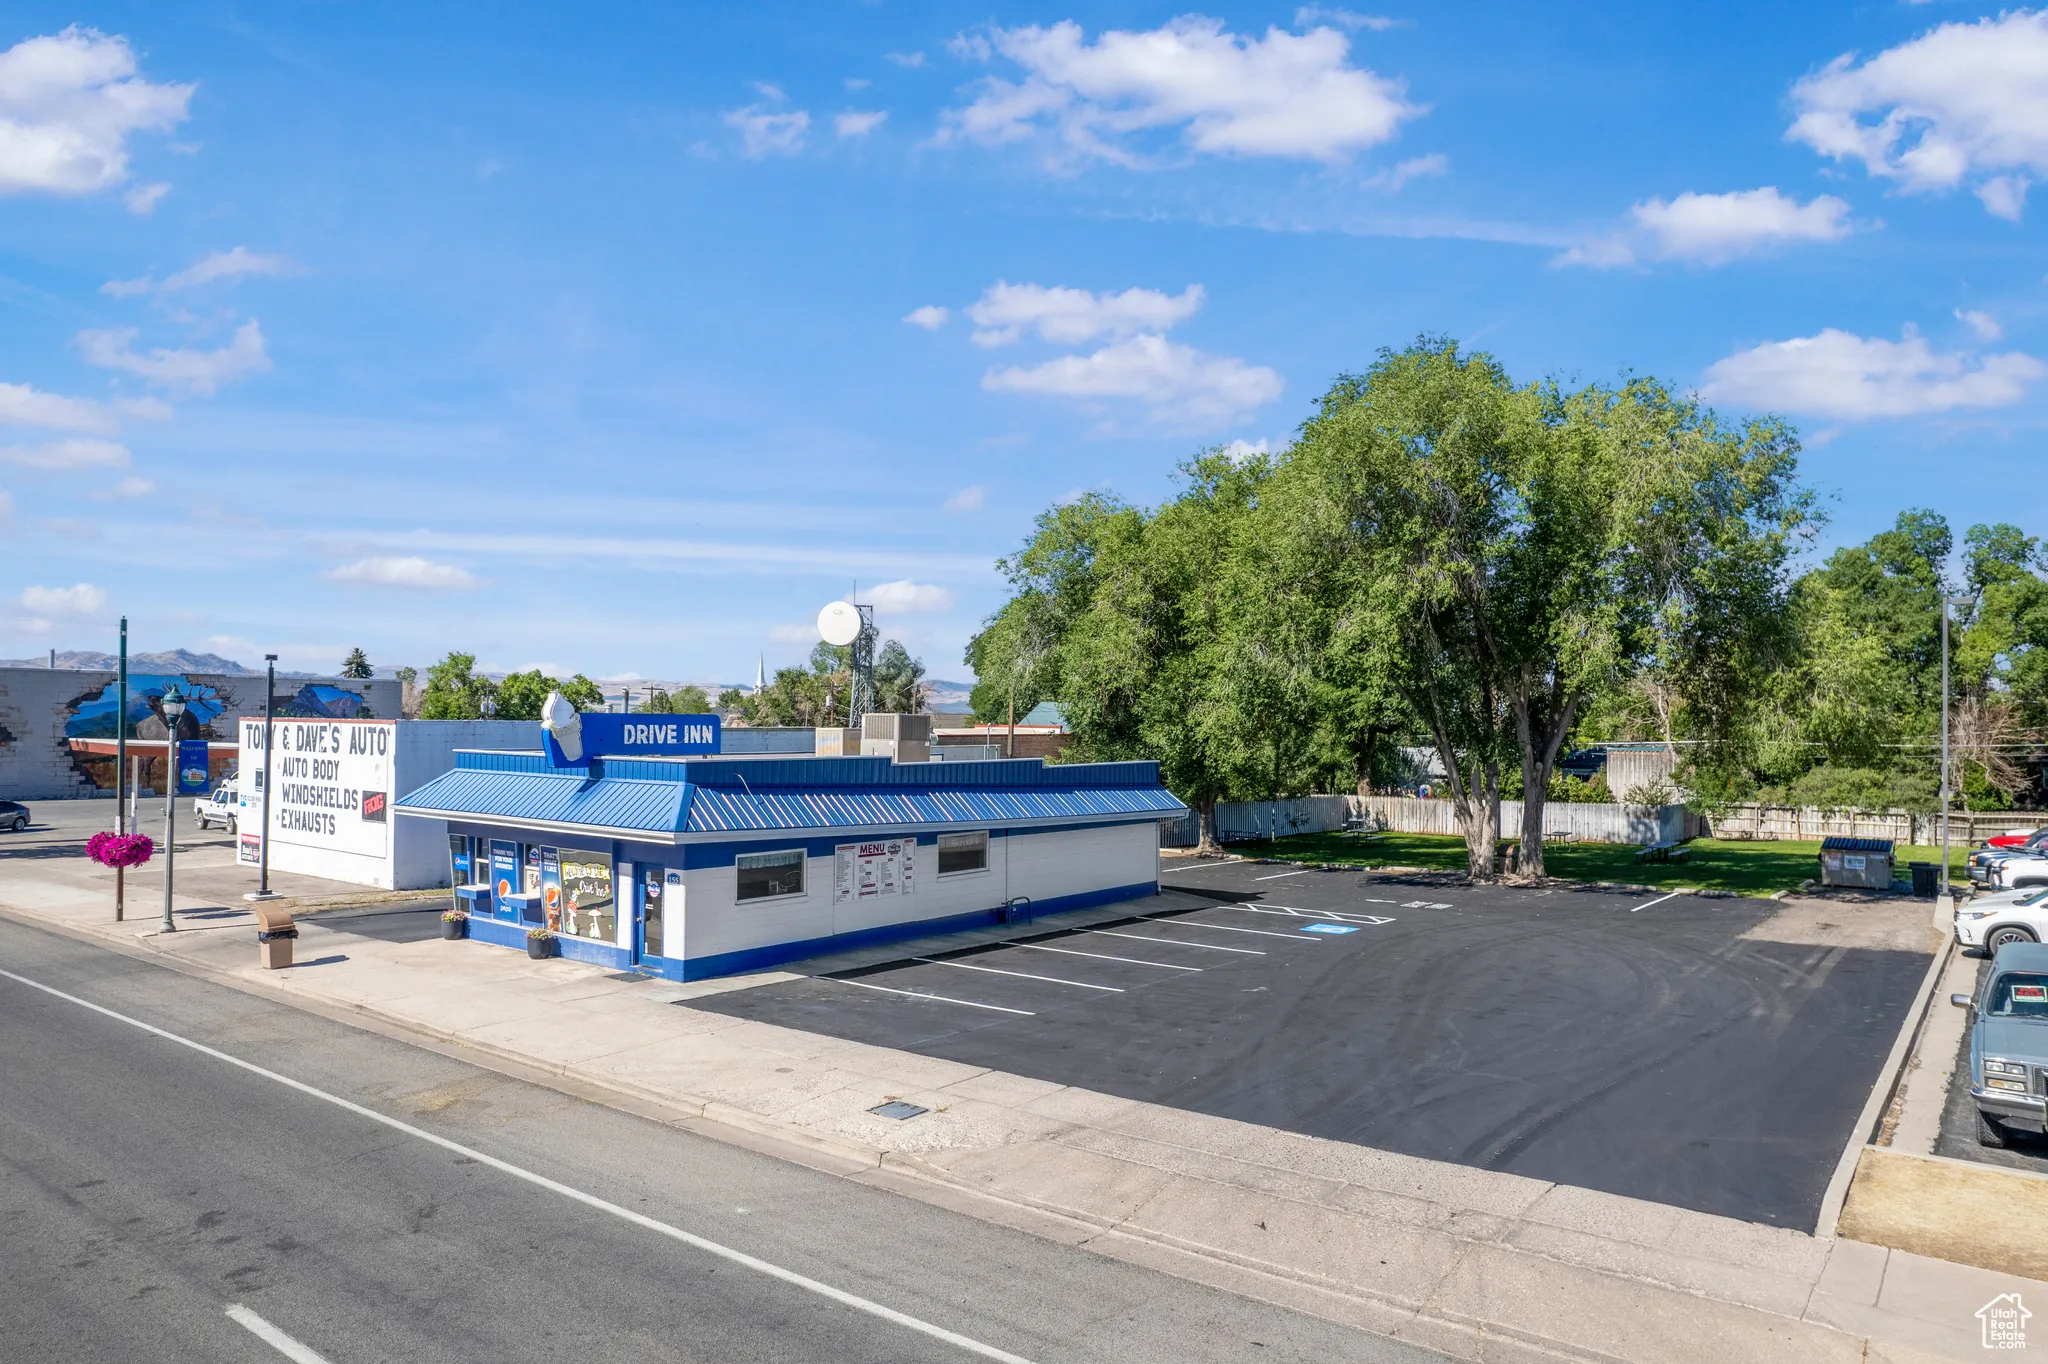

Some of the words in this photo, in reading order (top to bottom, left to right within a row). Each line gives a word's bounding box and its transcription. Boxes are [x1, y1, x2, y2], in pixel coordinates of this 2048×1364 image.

[282, 725, 290, 750] &
[296, 722, 341, 754] DAVE'S
[349, 726, 388, 756] AUTO
[624, 724, 677, 745] DRIVE
[684, 724, 713, 744] INN
[282, 757, 308, 779] AUTO
[313, 758, 340, 781] BODY
[282, 783, 359, 810] WINDSHIELDS
[281, 808, 336, 836] EXHAUSTS
[493, 848, 506, 856] THANK
[859, 843, 885, 855] MENU
[543, 851, 559, 860] THAT'S
[494, 862, 513, 870] BUSINESS
[546, 865, 558, 873] LIKE
[668, 876, 679, 884] 155
